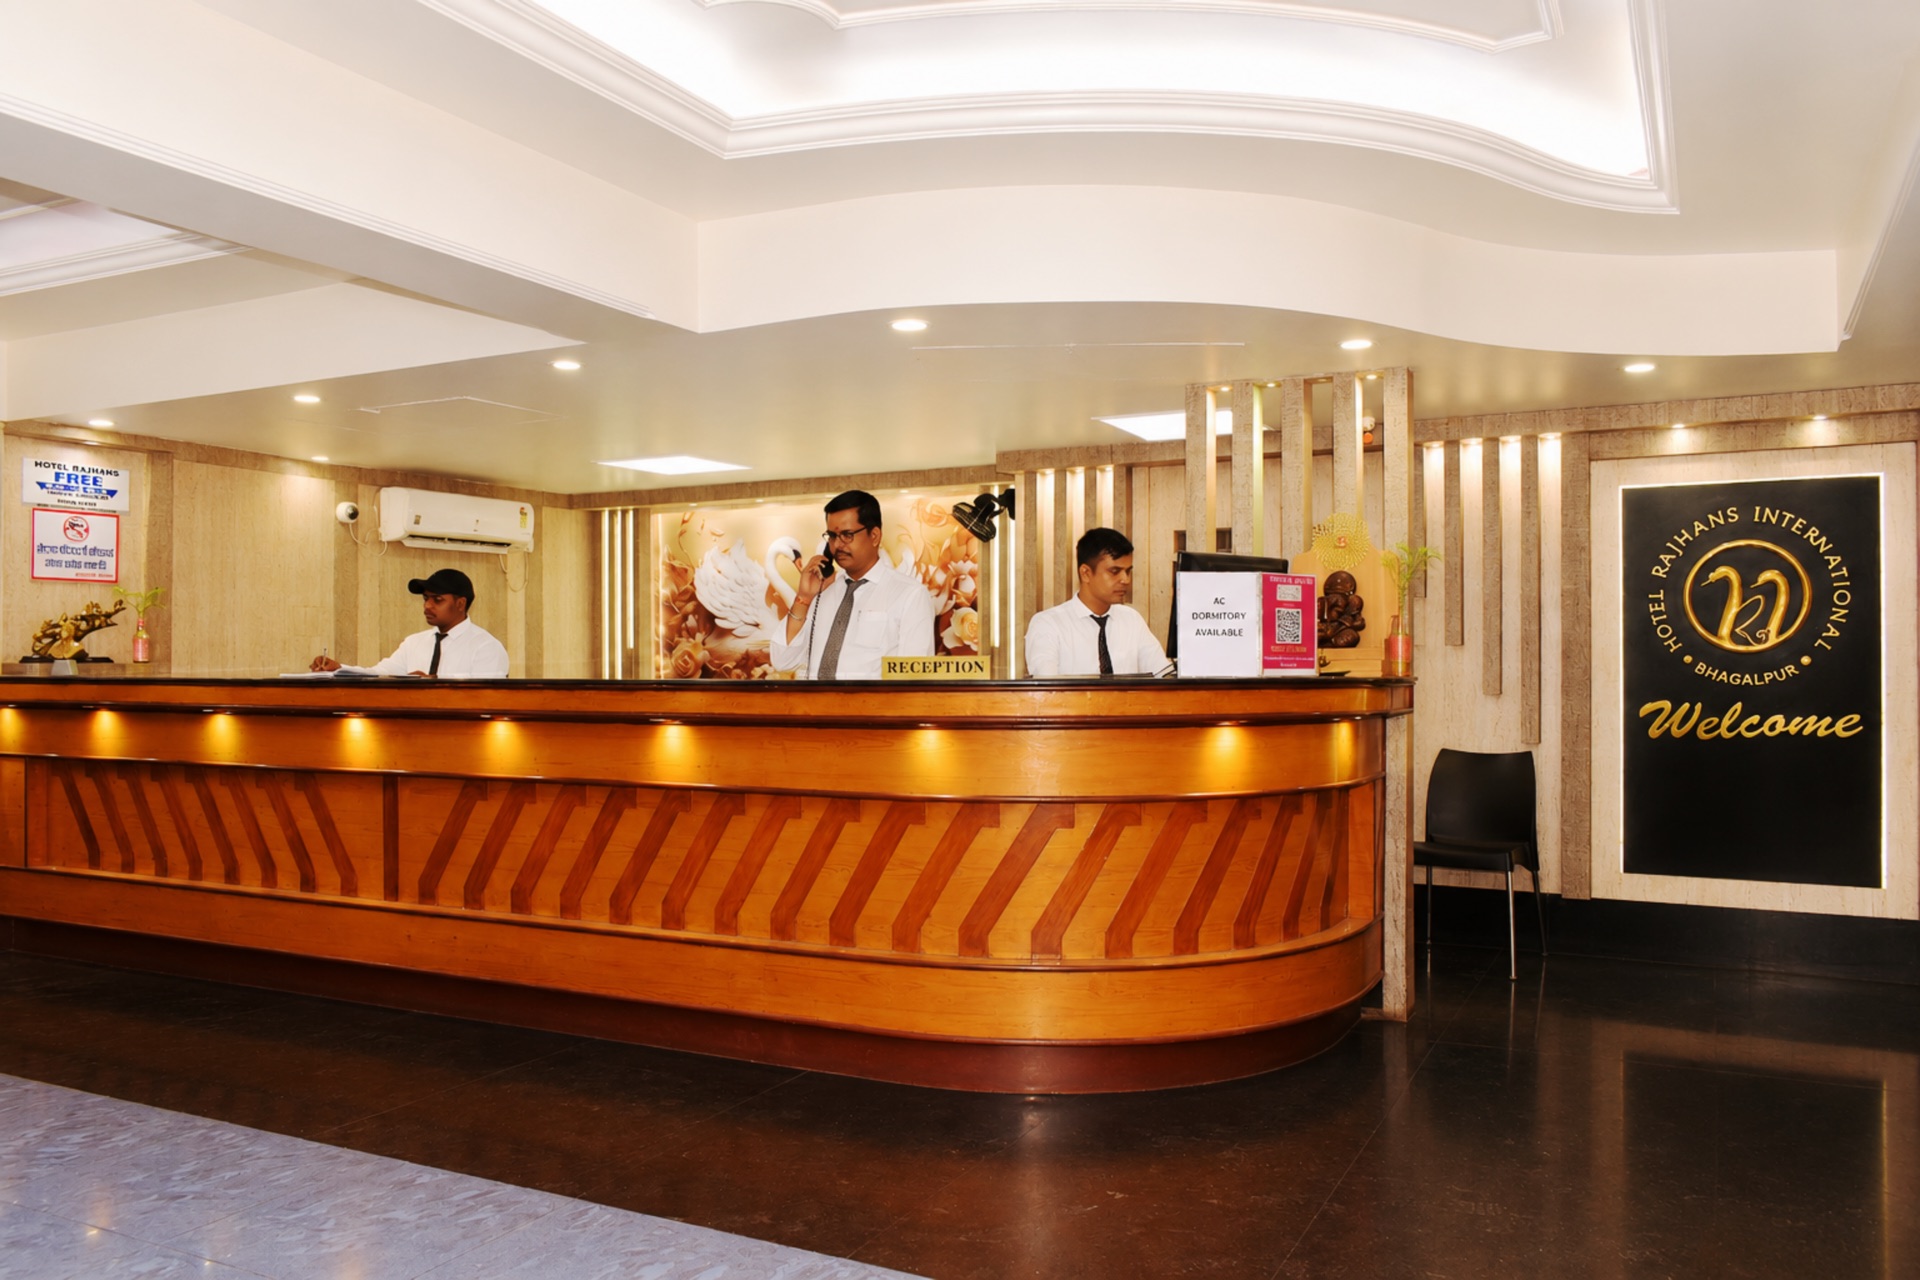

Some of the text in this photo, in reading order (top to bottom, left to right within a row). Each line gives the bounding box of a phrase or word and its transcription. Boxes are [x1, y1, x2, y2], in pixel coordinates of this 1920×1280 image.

[54, 471, 103, 487] FREE
[1648, 506, 1851, 653] HOTEL RAJHANS INTERNATIONAL
[1213, 597, 1226, 605] AC
[1191, 612, 1247, 621] DORMITORY
[1195, 628, 1244, 637] AVAILABLE
[886, 660, 984, 674] RECEPTION
[1694, 662, 1800, 686] BHAGALPUR
[1638, 699, 1864, 740] Welcome
